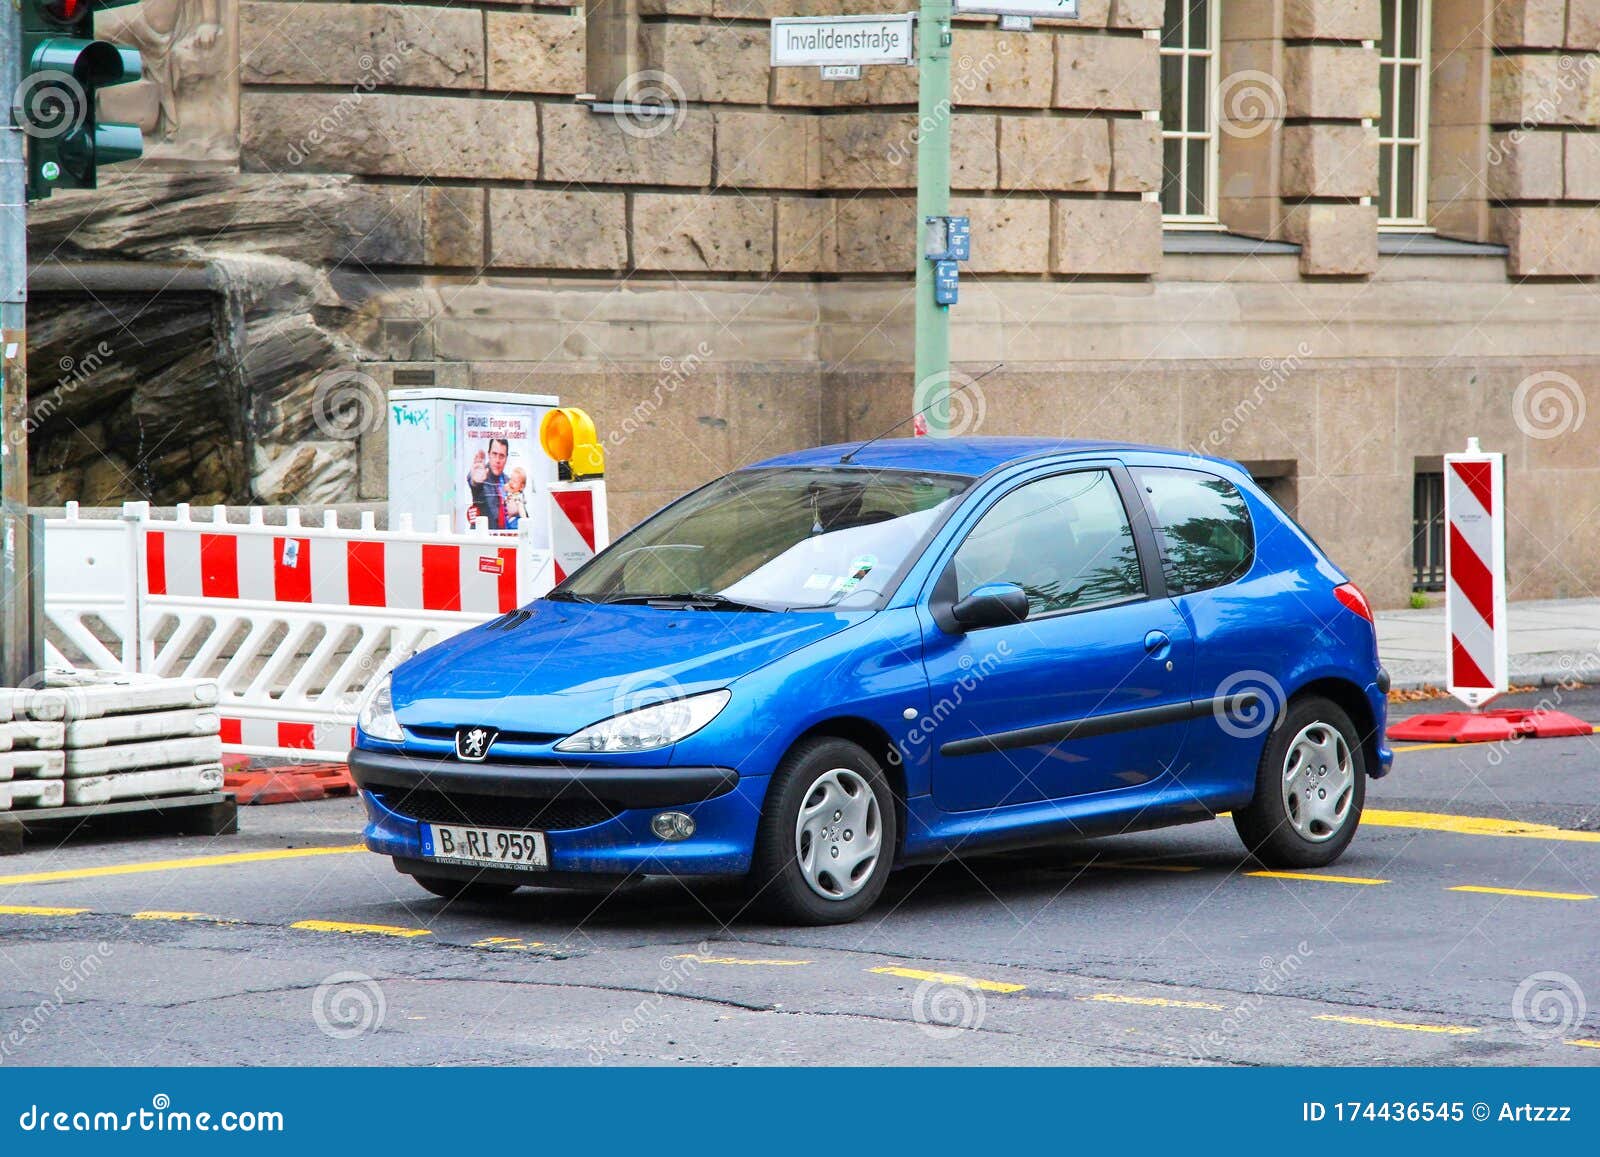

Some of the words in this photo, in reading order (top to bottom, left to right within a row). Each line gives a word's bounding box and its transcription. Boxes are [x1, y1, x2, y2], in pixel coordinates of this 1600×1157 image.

[786, 26, 899, 53] Invalidenstraße
[425, 842, 431, 851] D
[439, 828, 455, 853] B
[466, 830, 492, 858] RI
[497, 832, 536, 861] 959
